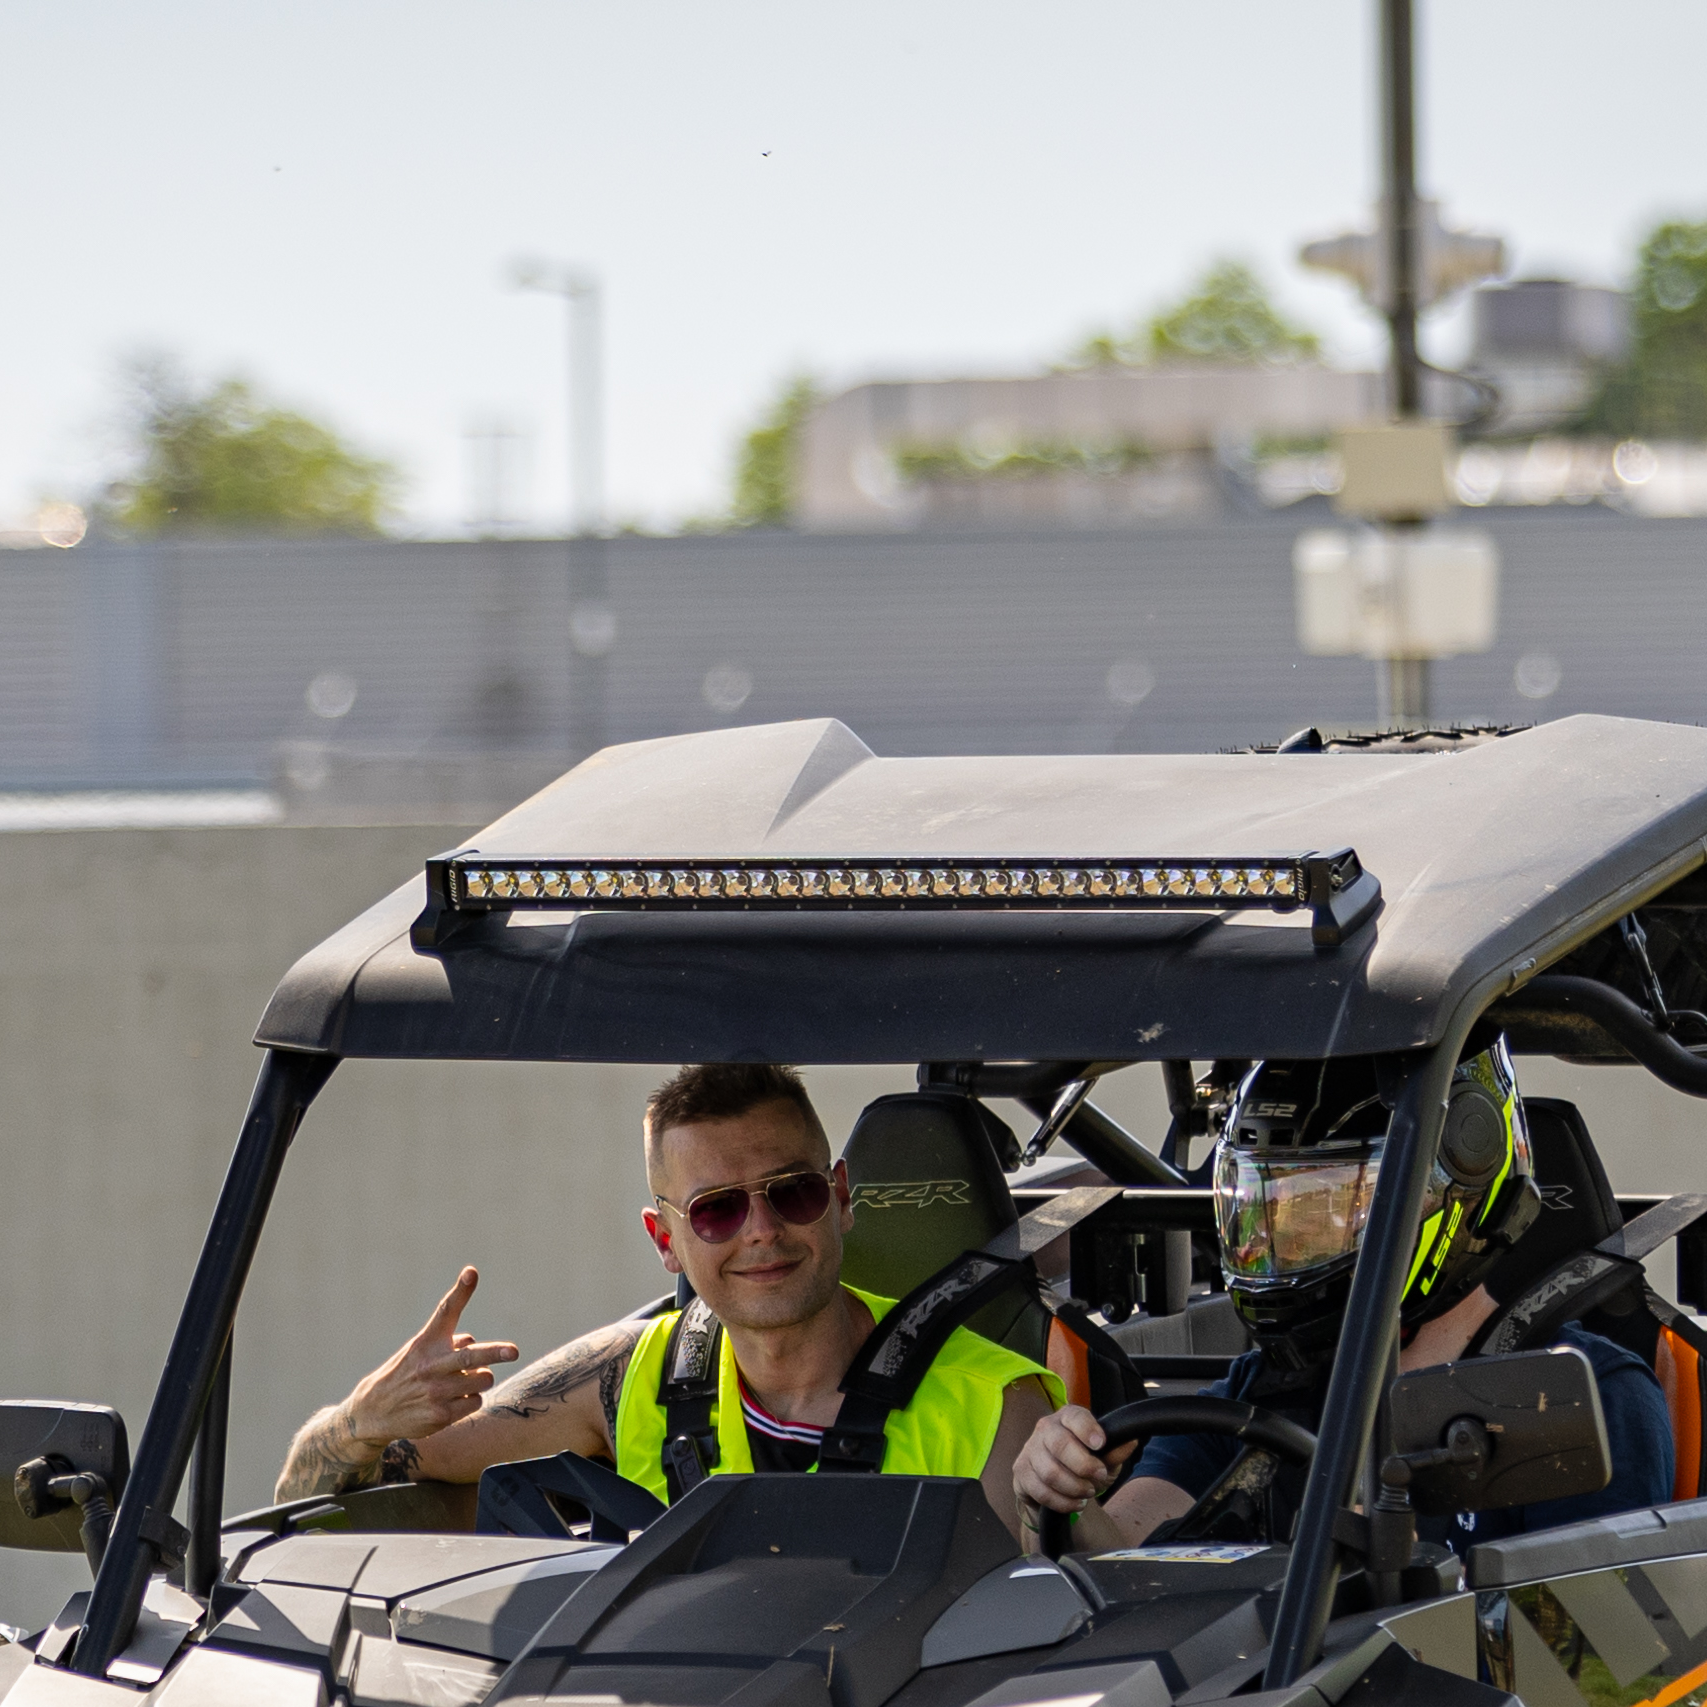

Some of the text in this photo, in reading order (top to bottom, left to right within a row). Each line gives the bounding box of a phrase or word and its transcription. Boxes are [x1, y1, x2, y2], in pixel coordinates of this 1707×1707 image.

[1242, 1102, 1298, 1118] LS2
[849, 1179, 972, 1209] RZR
[1419, 1199, 1464, 1296] LS2
